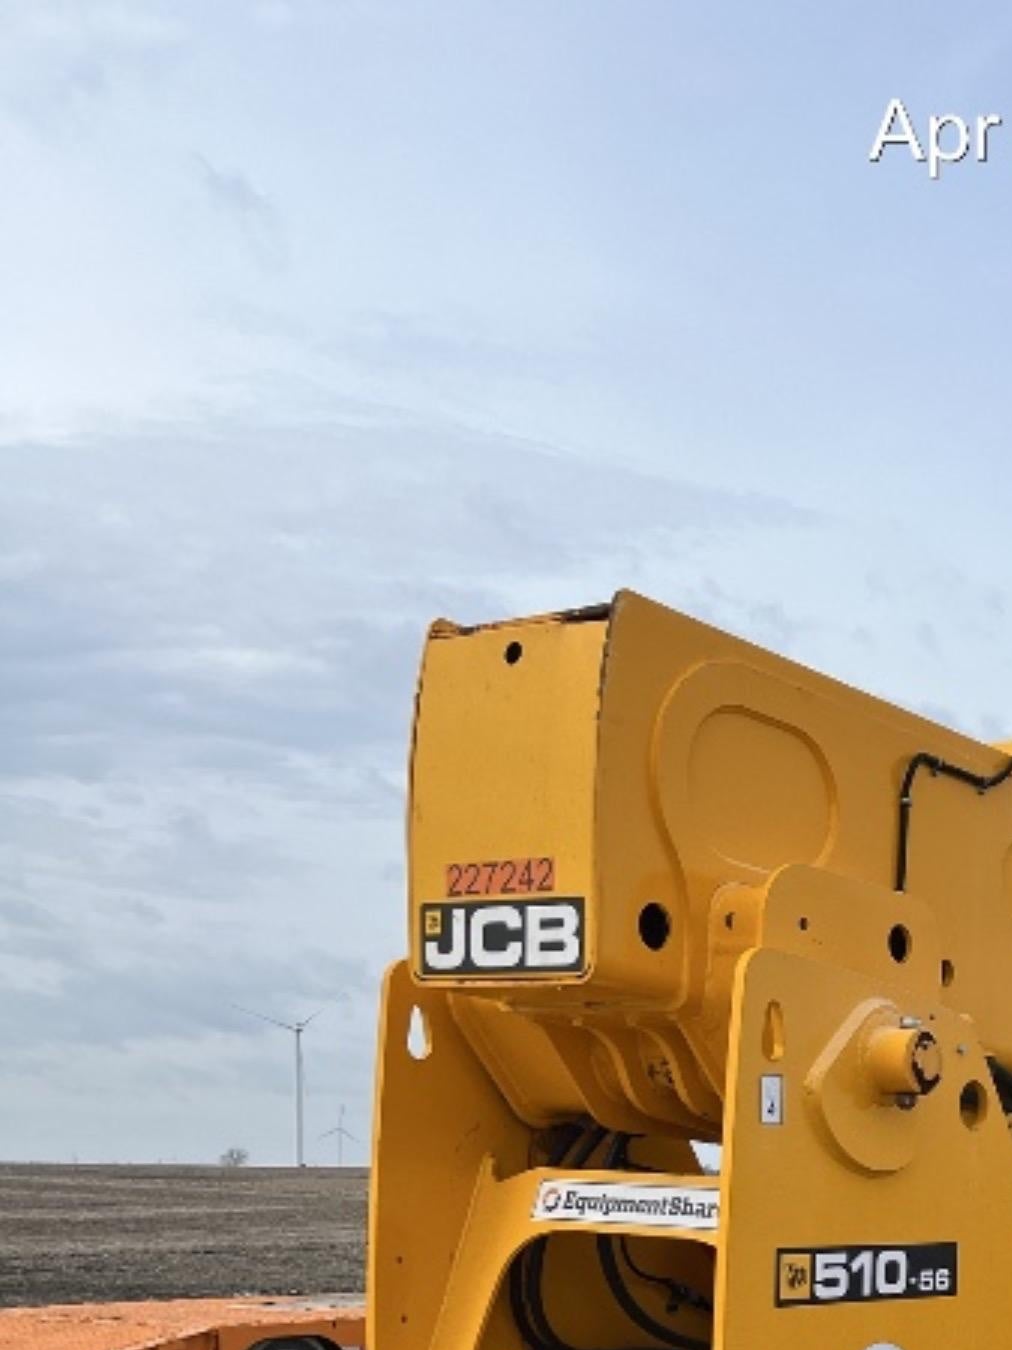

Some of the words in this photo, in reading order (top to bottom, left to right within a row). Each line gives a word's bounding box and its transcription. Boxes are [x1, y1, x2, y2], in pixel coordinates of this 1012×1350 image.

[447, 857, 554, 897] 227242
[425, 905, 580, 969] JCB
[563, 1190, 719, 1219] EquipmentShar
